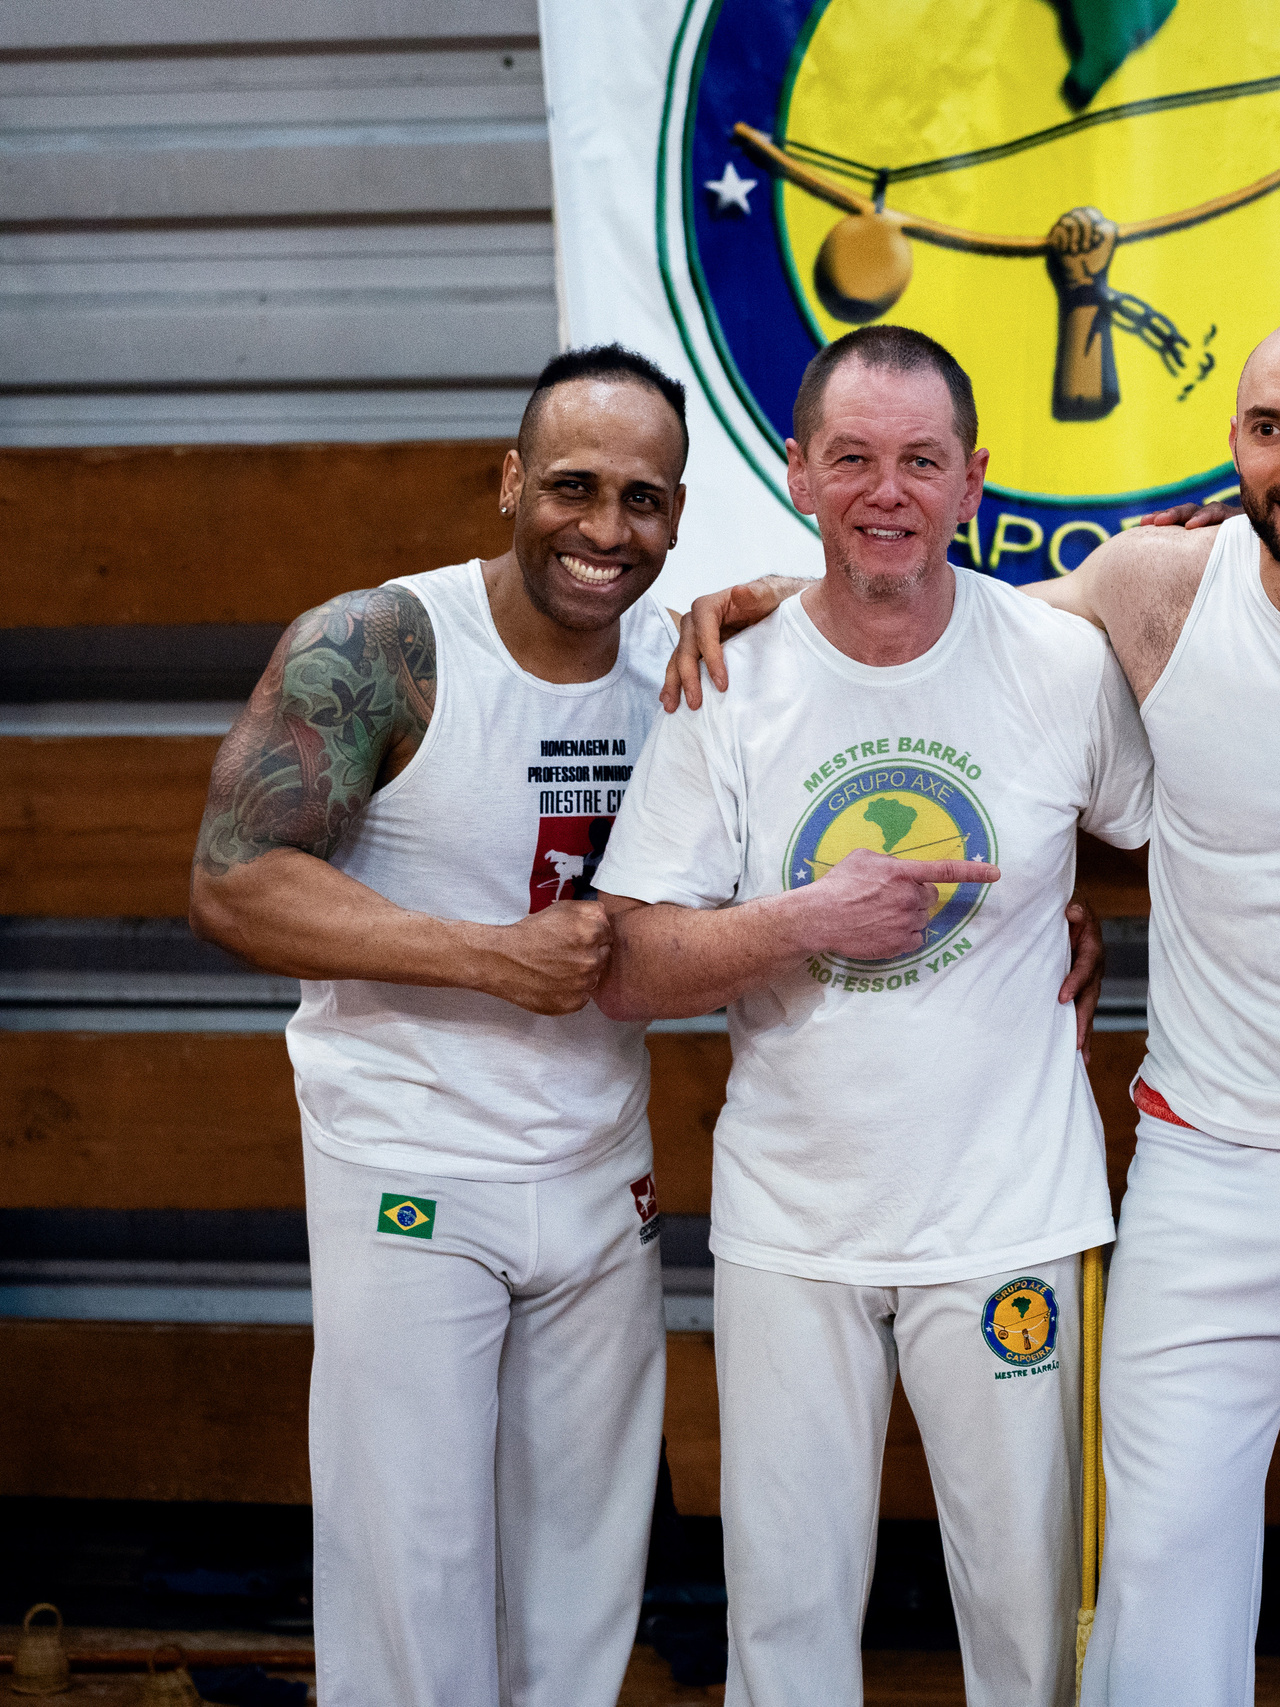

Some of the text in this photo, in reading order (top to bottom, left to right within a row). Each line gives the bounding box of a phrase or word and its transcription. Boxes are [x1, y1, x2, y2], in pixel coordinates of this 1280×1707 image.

[540, 739, 626, 757] HOMENAGEM AO
[527, 766, 590, 783] PROFESSOR
[802, 737, 982, 794] MESTRE BARRÃO
[828, 771, 906, 811] GRUPO
[540, 790, 602, 814] MESTRE
[925, 937, 973, 974] YAN
[995, 1280, 1027, 1301] GRUPO
[1005, 1345, 1052, 1362] CAPOEIRA
[994, 1369, 1028, 1380] MESTRE
